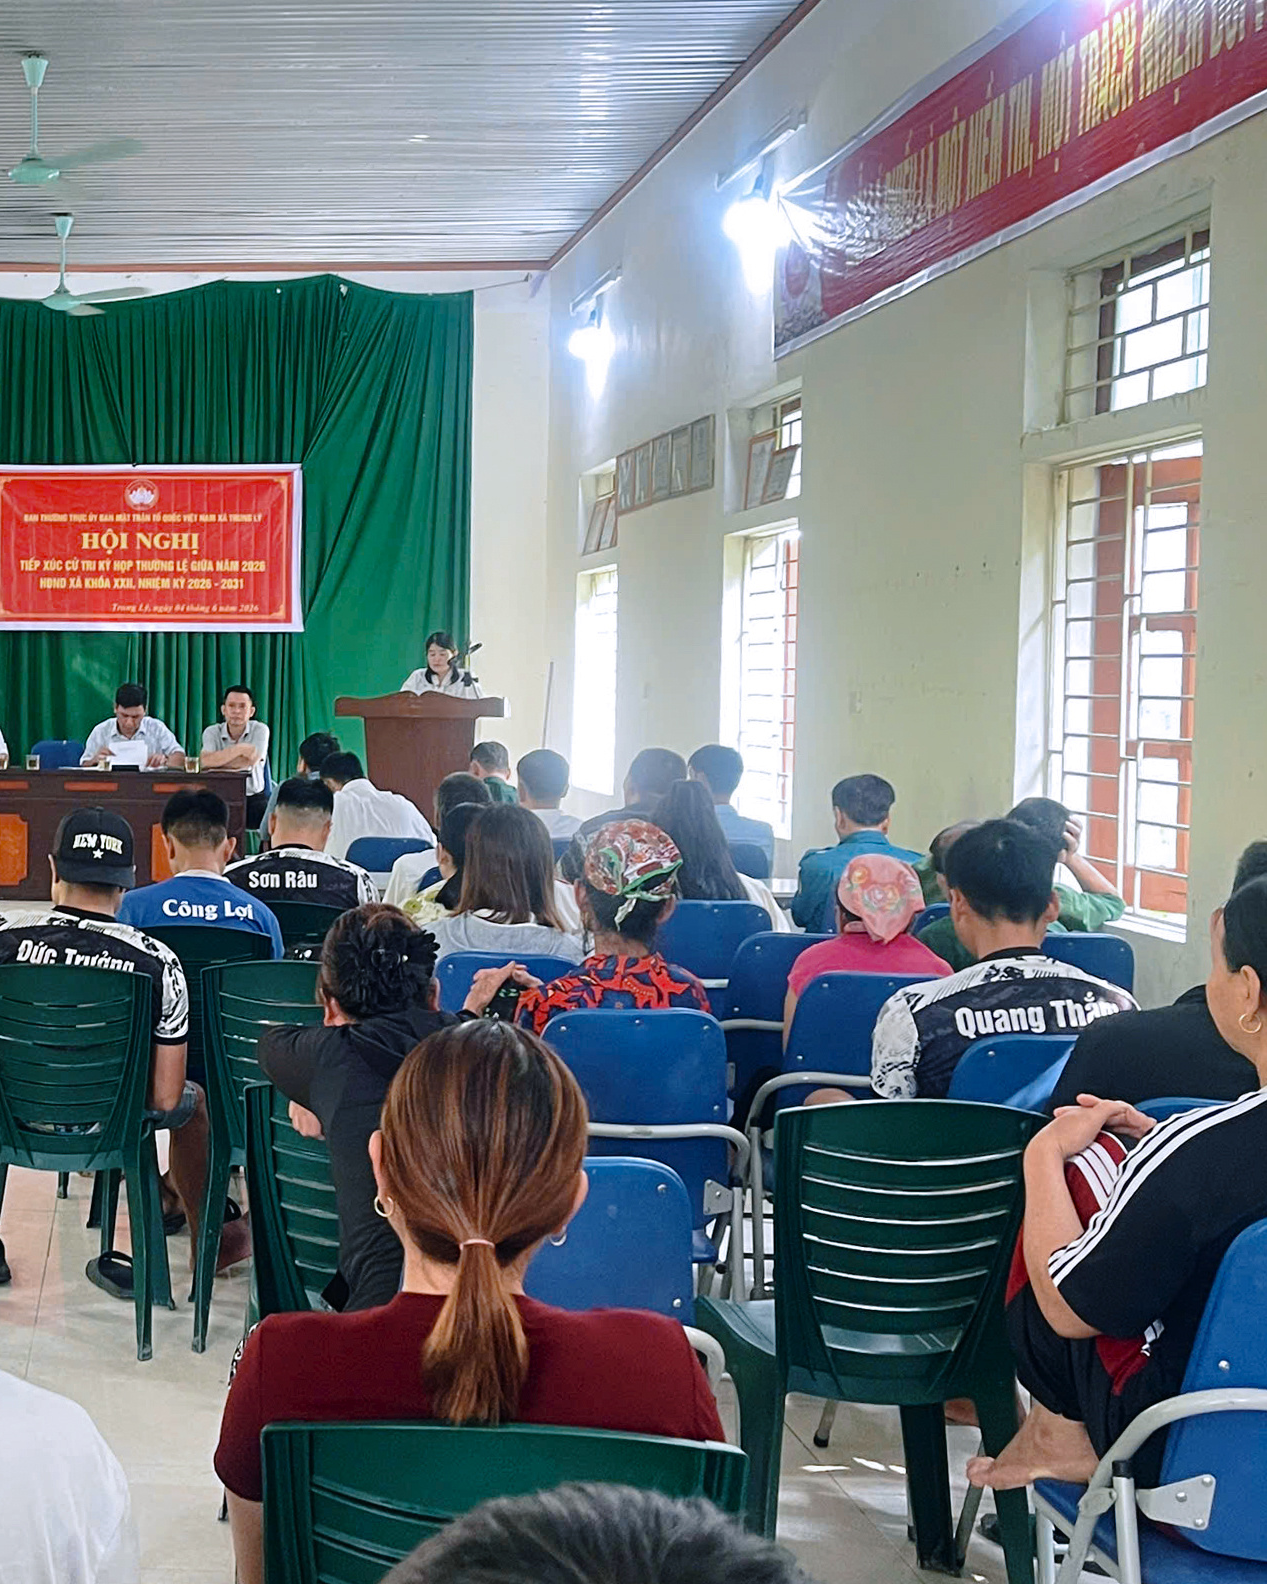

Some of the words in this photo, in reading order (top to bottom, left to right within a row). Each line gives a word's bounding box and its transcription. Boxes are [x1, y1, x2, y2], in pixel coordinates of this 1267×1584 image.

[1037, 30, 1076, 173] MỘT
[81, 528, 129, 555] HỘI
[135, 532, 200, 555] NGHỊ
[20, 556, 41, 572] TIẾP
[42, 558, 63, 572] XÚC
[65, 556, 80, 572] CỬ
[80, 560, 96, 572] TRI
[135, 558, 175, 572] THƯỜNG
[176, 558, 189, 574] LỆ
[190, 559, 215, 572] GIỮA
[215, 558, 240, 572] NĂM
[241, 560, 266, 572] 2026
[68, 576, 83, 590] XÃ
[84, 575, 111, 590] KHÓA
[138, 577, 171, 591] NHIỆM
[187, 579, 212, 590] 2026
[220, 579, 244, 590] 2031
[112, 603, 137, 613] Trung
[153, 603, 173, 614] ngày
[218, 603, 239, 612] năm
[239, 603, 259, 612] 2026
[73, 833, 98, 849] NEW
[99, 834, 123, 855] YORK
[248, 871, 280, 888] Sơn
[284, 870, 318, 888] Râu
[162, 898, 218, 920] Công
[224, 901, 254, 921] Lợi
[16, 939, 58, 965] Đức
[954, 1006, 1047, 1040] Quang
